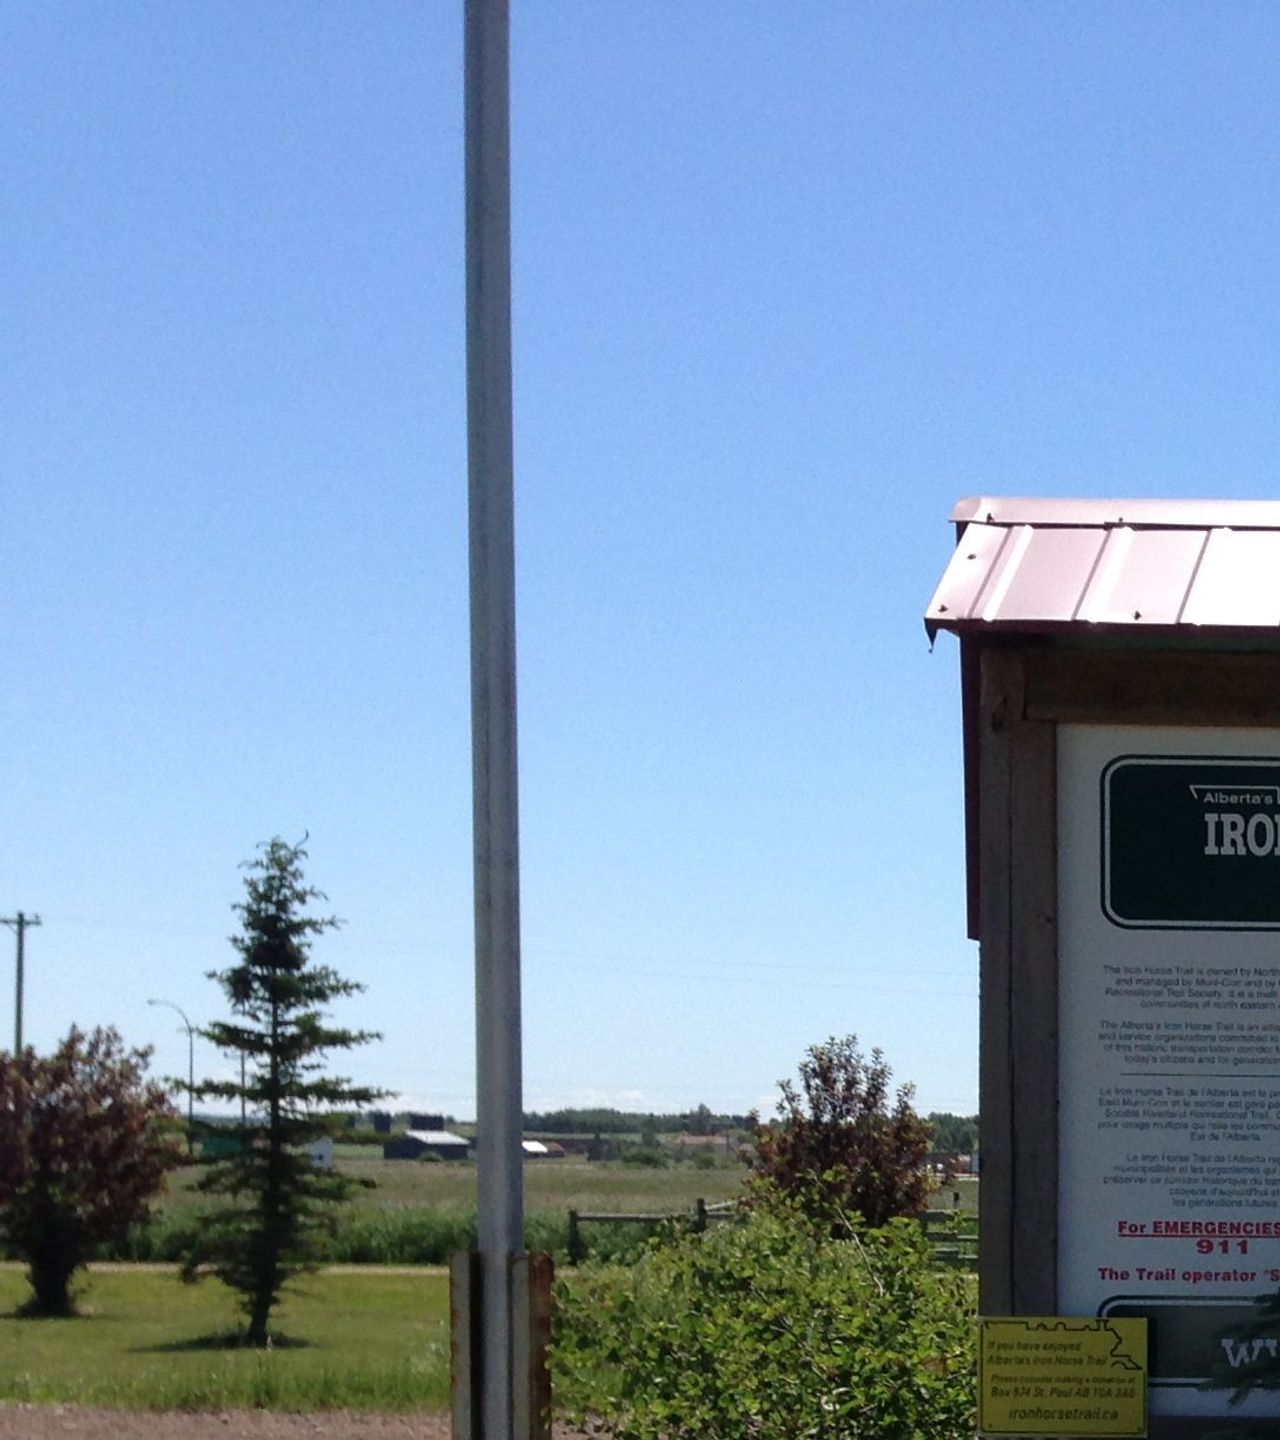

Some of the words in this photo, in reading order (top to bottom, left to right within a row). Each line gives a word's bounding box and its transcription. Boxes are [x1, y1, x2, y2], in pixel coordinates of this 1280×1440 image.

[1203, 791, 1274, 805] Alberta's
[1118, 1221, 1146, 1234] For
[1197, 1239, 1249, 1254] 911
[1098, 1269, 1130, 1280] The
[1136, 1269, 1175, 1281] Trail
[1182, 1270, 1257, 1284] operator
